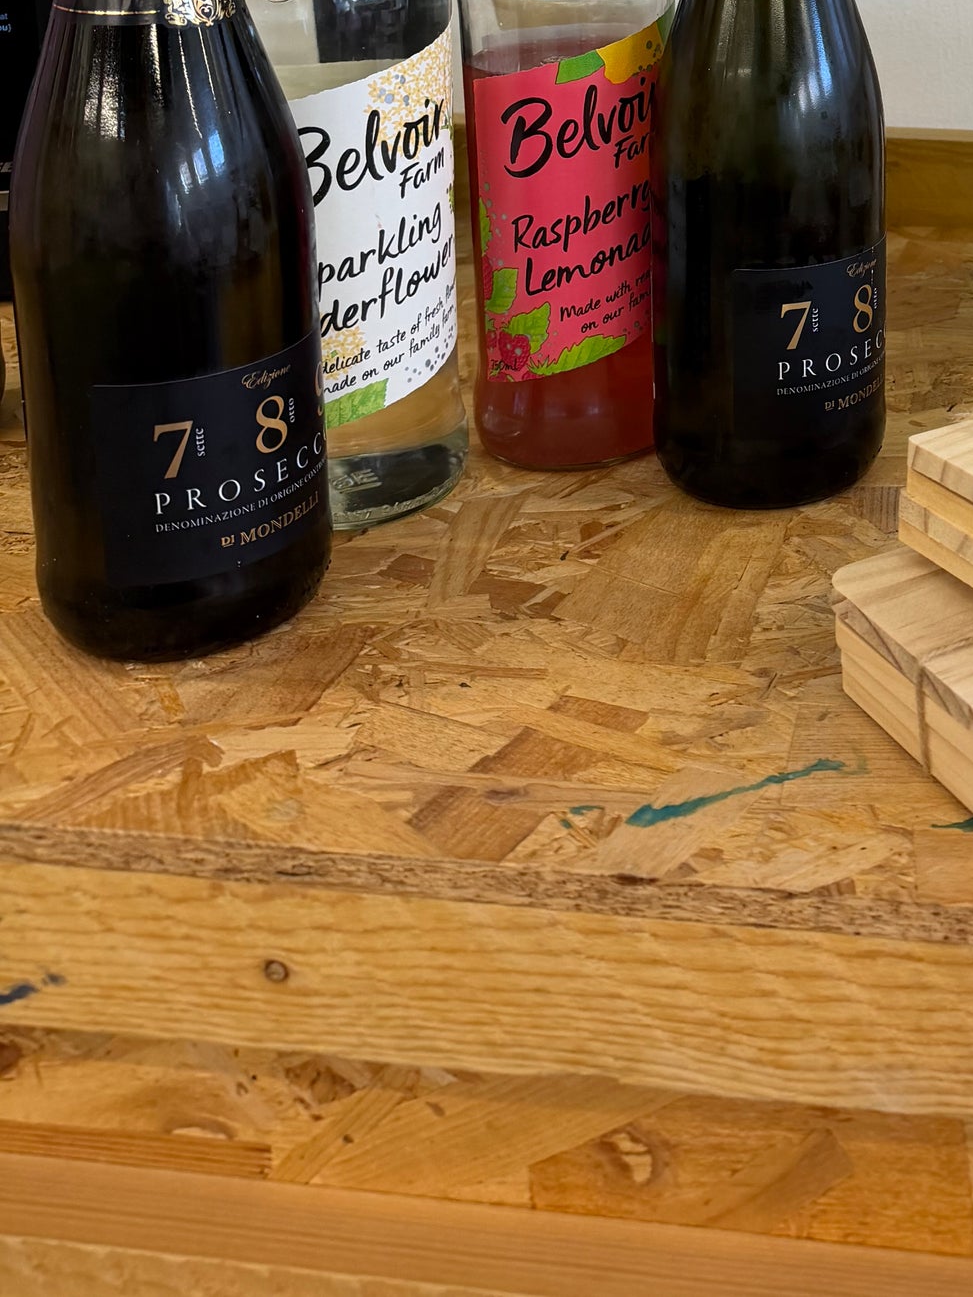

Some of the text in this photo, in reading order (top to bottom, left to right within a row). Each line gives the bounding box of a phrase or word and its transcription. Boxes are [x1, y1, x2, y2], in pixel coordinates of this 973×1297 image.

[399, 146, 445, 199] Farm
[511, 180, 652, 252] Raspberry
[376, 329, 407, 354] taste
[410, 312, 422, 335] of
[424, 296, 444, 326] fresh
[560, 298, 601, 322] Made
[605, 280, 631, 303] with
[580, 321, 599, 334] on
[602, 306, 625, 324] our
[780, 284, 874, 351] 7 8
[241, 364, 292, 390] Edizione
[362, 368, 379, 381] on
[383, 352, 405, 371] our
[409, 323, 441, 358] family
[776, 373, 850, 396] DENOMINAZIONE
[851, 370, 860, 380] DI
[824, 401, 835, 411] DI
[153, 395, 288, 479] 7 8
[195, 427, 205, 457] sette
[155, 502, 256, 533] DENOMINAZIONE
[258, 499, 269, 509] DI
[270, 480, 303, 502] ORIGINE
[221, 491, 320, 548] DI MONDELLI
